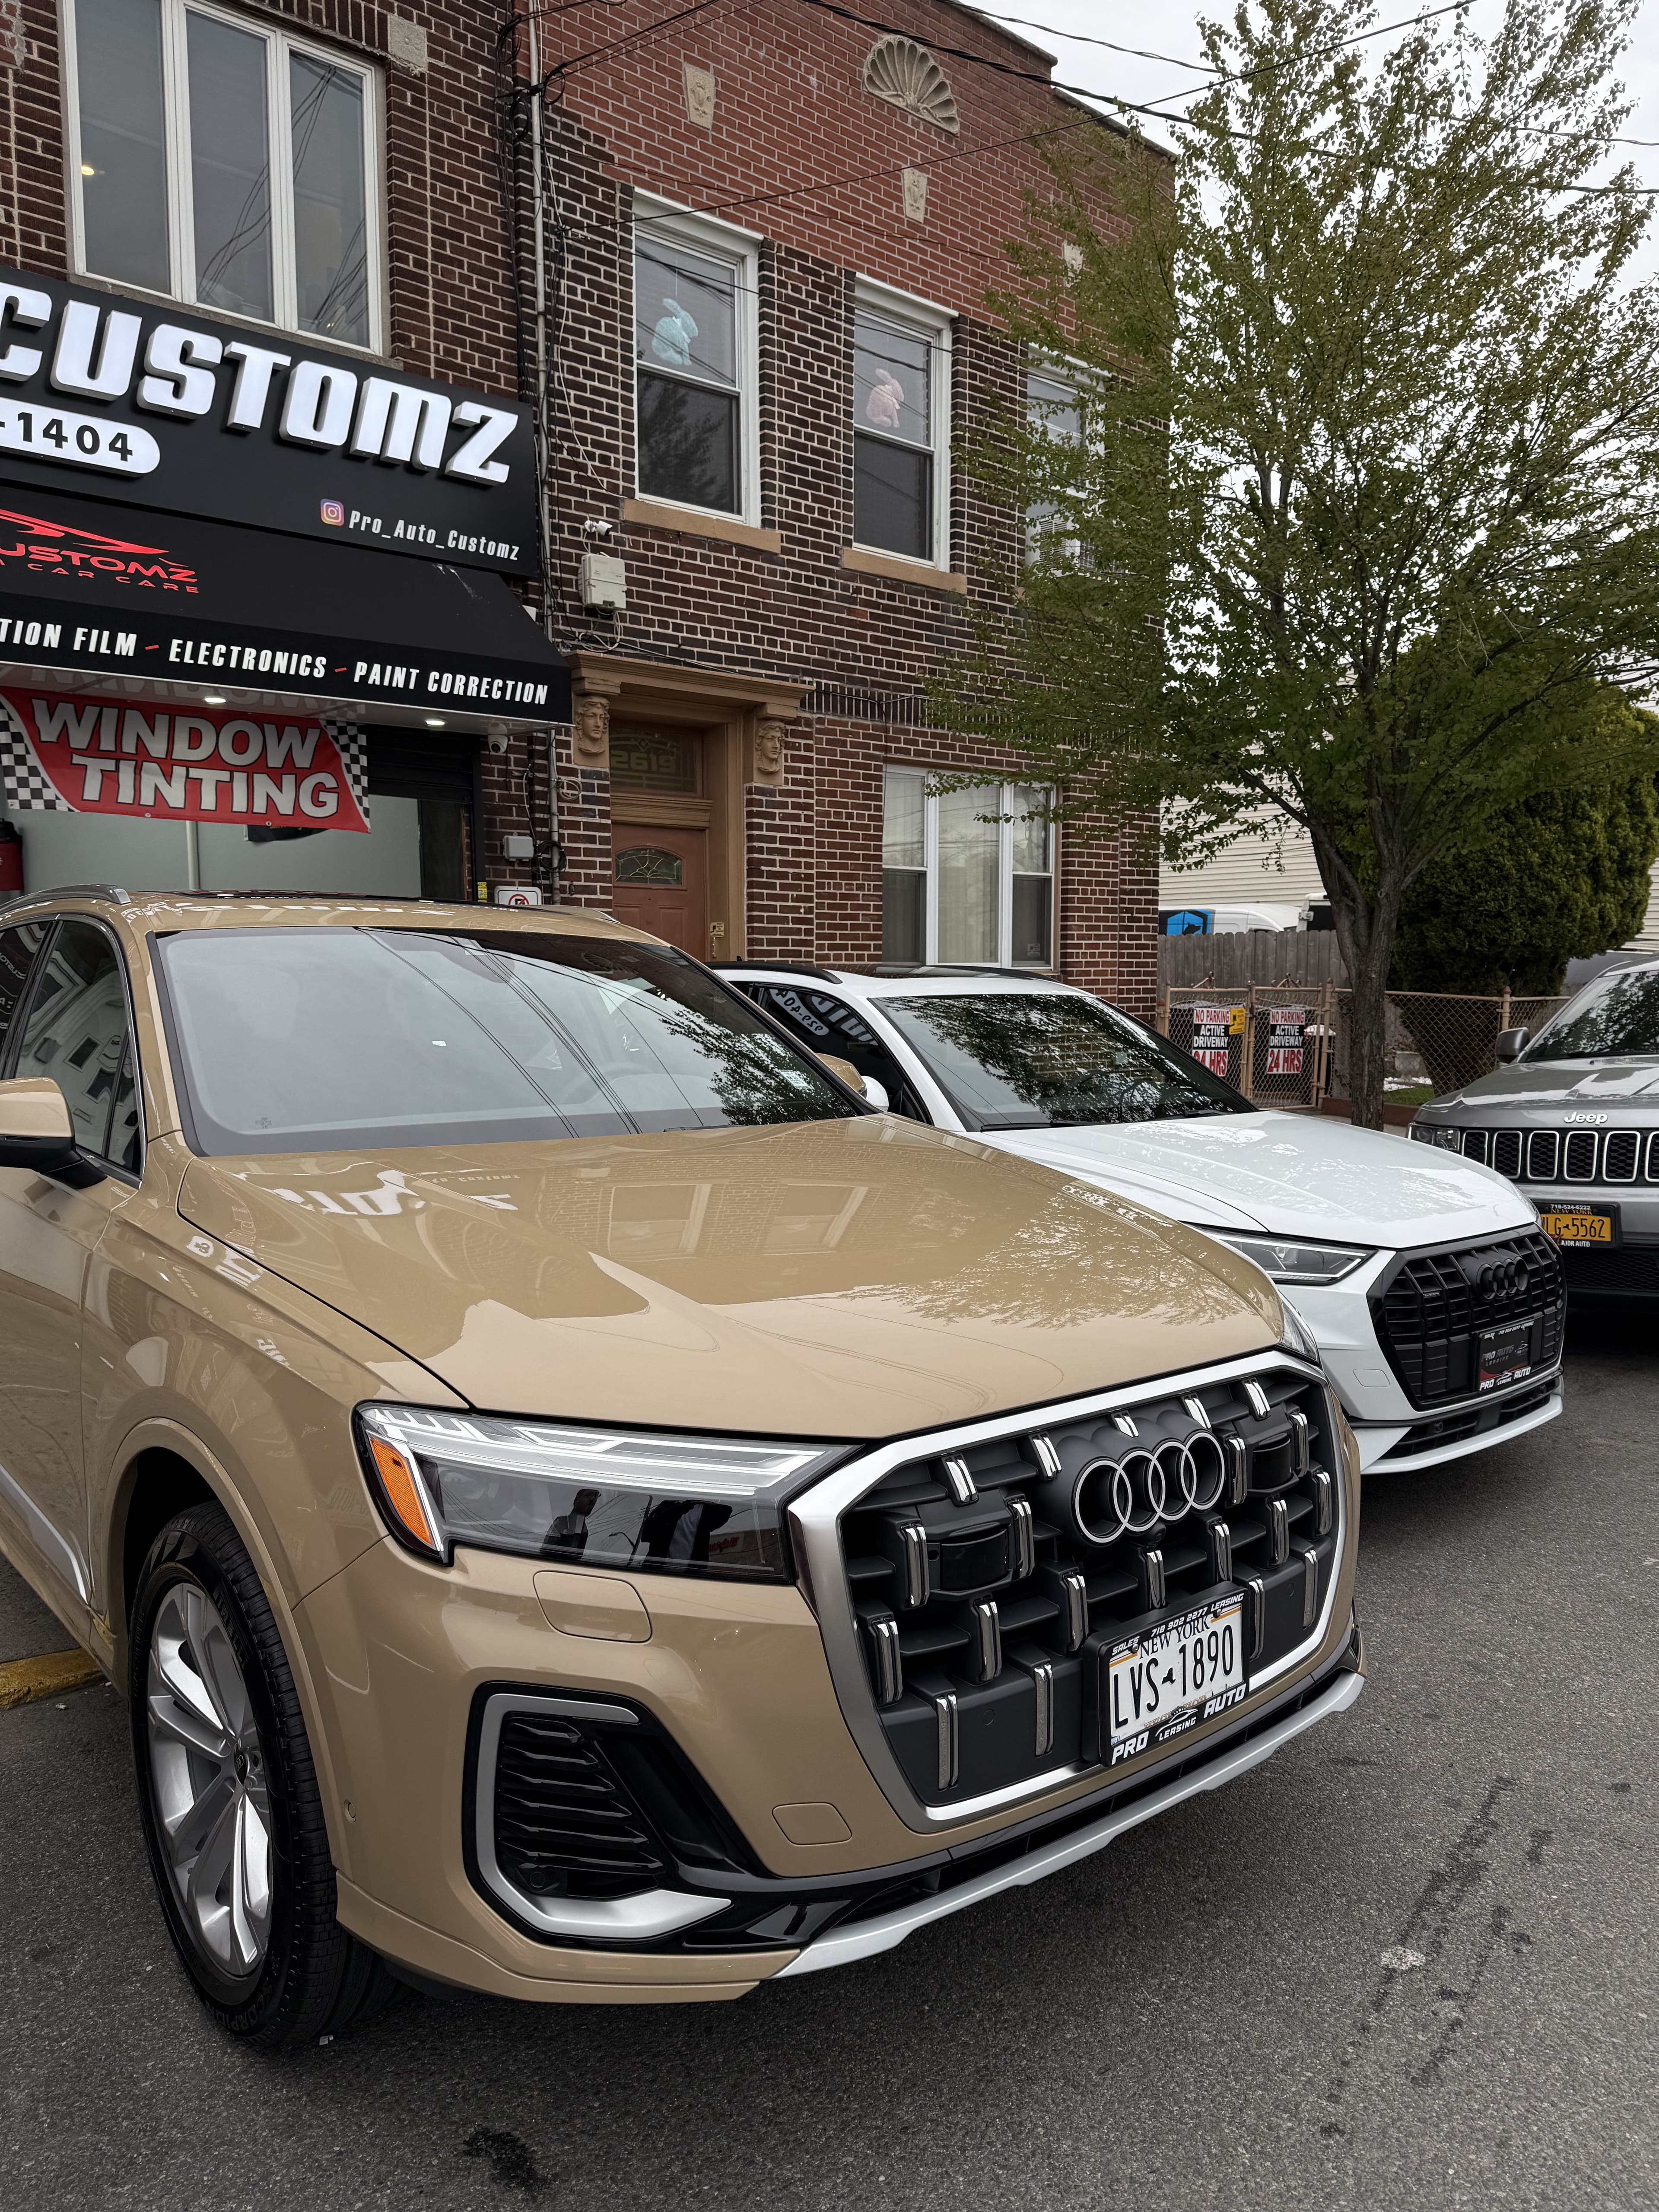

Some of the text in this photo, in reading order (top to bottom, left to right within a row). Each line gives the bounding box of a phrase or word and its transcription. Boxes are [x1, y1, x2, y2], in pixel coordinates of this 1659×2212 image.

[349, 510, 520, 560] Pro_Auto_Customz
[27, 563, 200, 594] CAR CARE
[73, 627, 137, 657] FILM
[169, 639, 327, 678] ELECTRONICS
[353, 661, 420, 690] PAINT
[427, 671, 548, 705] CORRECTION
[31, 698, 321, 769] WINDOW
[70, 752, 339, 819] TINTING
[1195, 1009, 1205, 1023] NO
[1206, 1009, 1230, 1023] PARKING
[1271, 1011, 1304, 1024] NO PARKING
[1193, 1036, 1229, 1048] DRIVEWAY
[1200, 1025, 1225, 1036] ACTIVE
[1270, 1036, 1303, 1047] DRIVEWAY
[1275, 1025, 1299, 1036] ACTIVE
[1210, 1050, 1227, 1075] HRS
[1268, 1049, 1302, 1073] 24 HRS
[1564, 1111, 1608, 1125] Jeep
[1479, 1379, 1495, 1391] PRO
[1514, 1367, 1532, 1379] AUTO
[1112, 1593, 1244, 1656] SALES 718 902 2277 LEASING
[1139, 1616, 1211, 1659] NEW YORK
[1111, 1731, 1149, 1765] PRO
[1158, 1716, 1196, 1742] LEASING
[1203, 1683, 1247, 1719] AUTO
